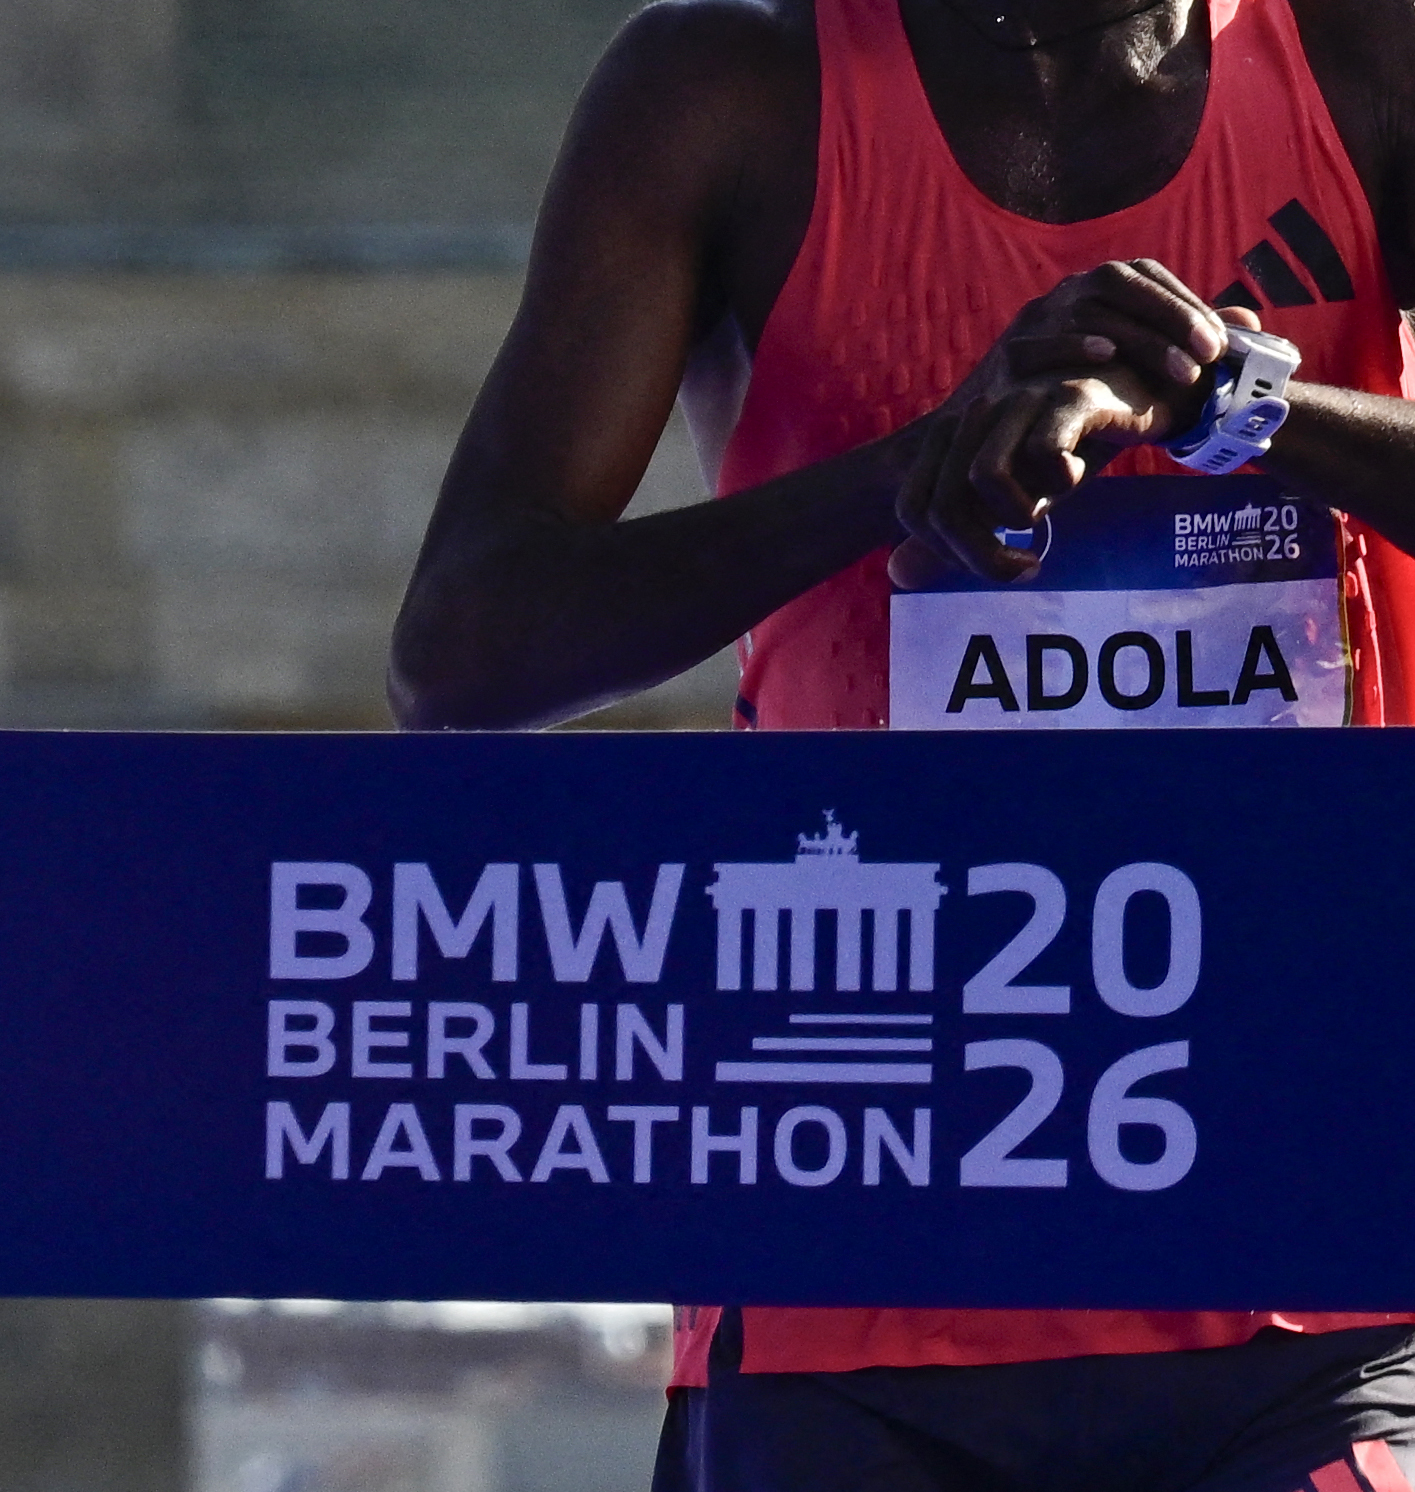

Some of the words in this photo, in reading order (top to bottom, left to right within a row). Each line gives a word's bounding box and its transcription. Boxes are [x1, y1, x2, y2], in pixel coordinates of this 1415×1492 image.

[1175, 511, 1232, 534] BMW
[1175, 534, 1230, 551] BERLIN
[1175, 547, 1263, 568] MARATHON
[1264, 505, 1298, 531] 20
[1265, 533, 1300, 559] 26
[946, 625, 1298, 713] ADOLA
[270, 862, 685, 982] BMW
[963, 862, 1201, 1017] 20
[268, 1000, 684, 1081] BERLIN
[265, 1102, 931, 1187] MARATHON
[960, 1039, 1197, 1191] 26
